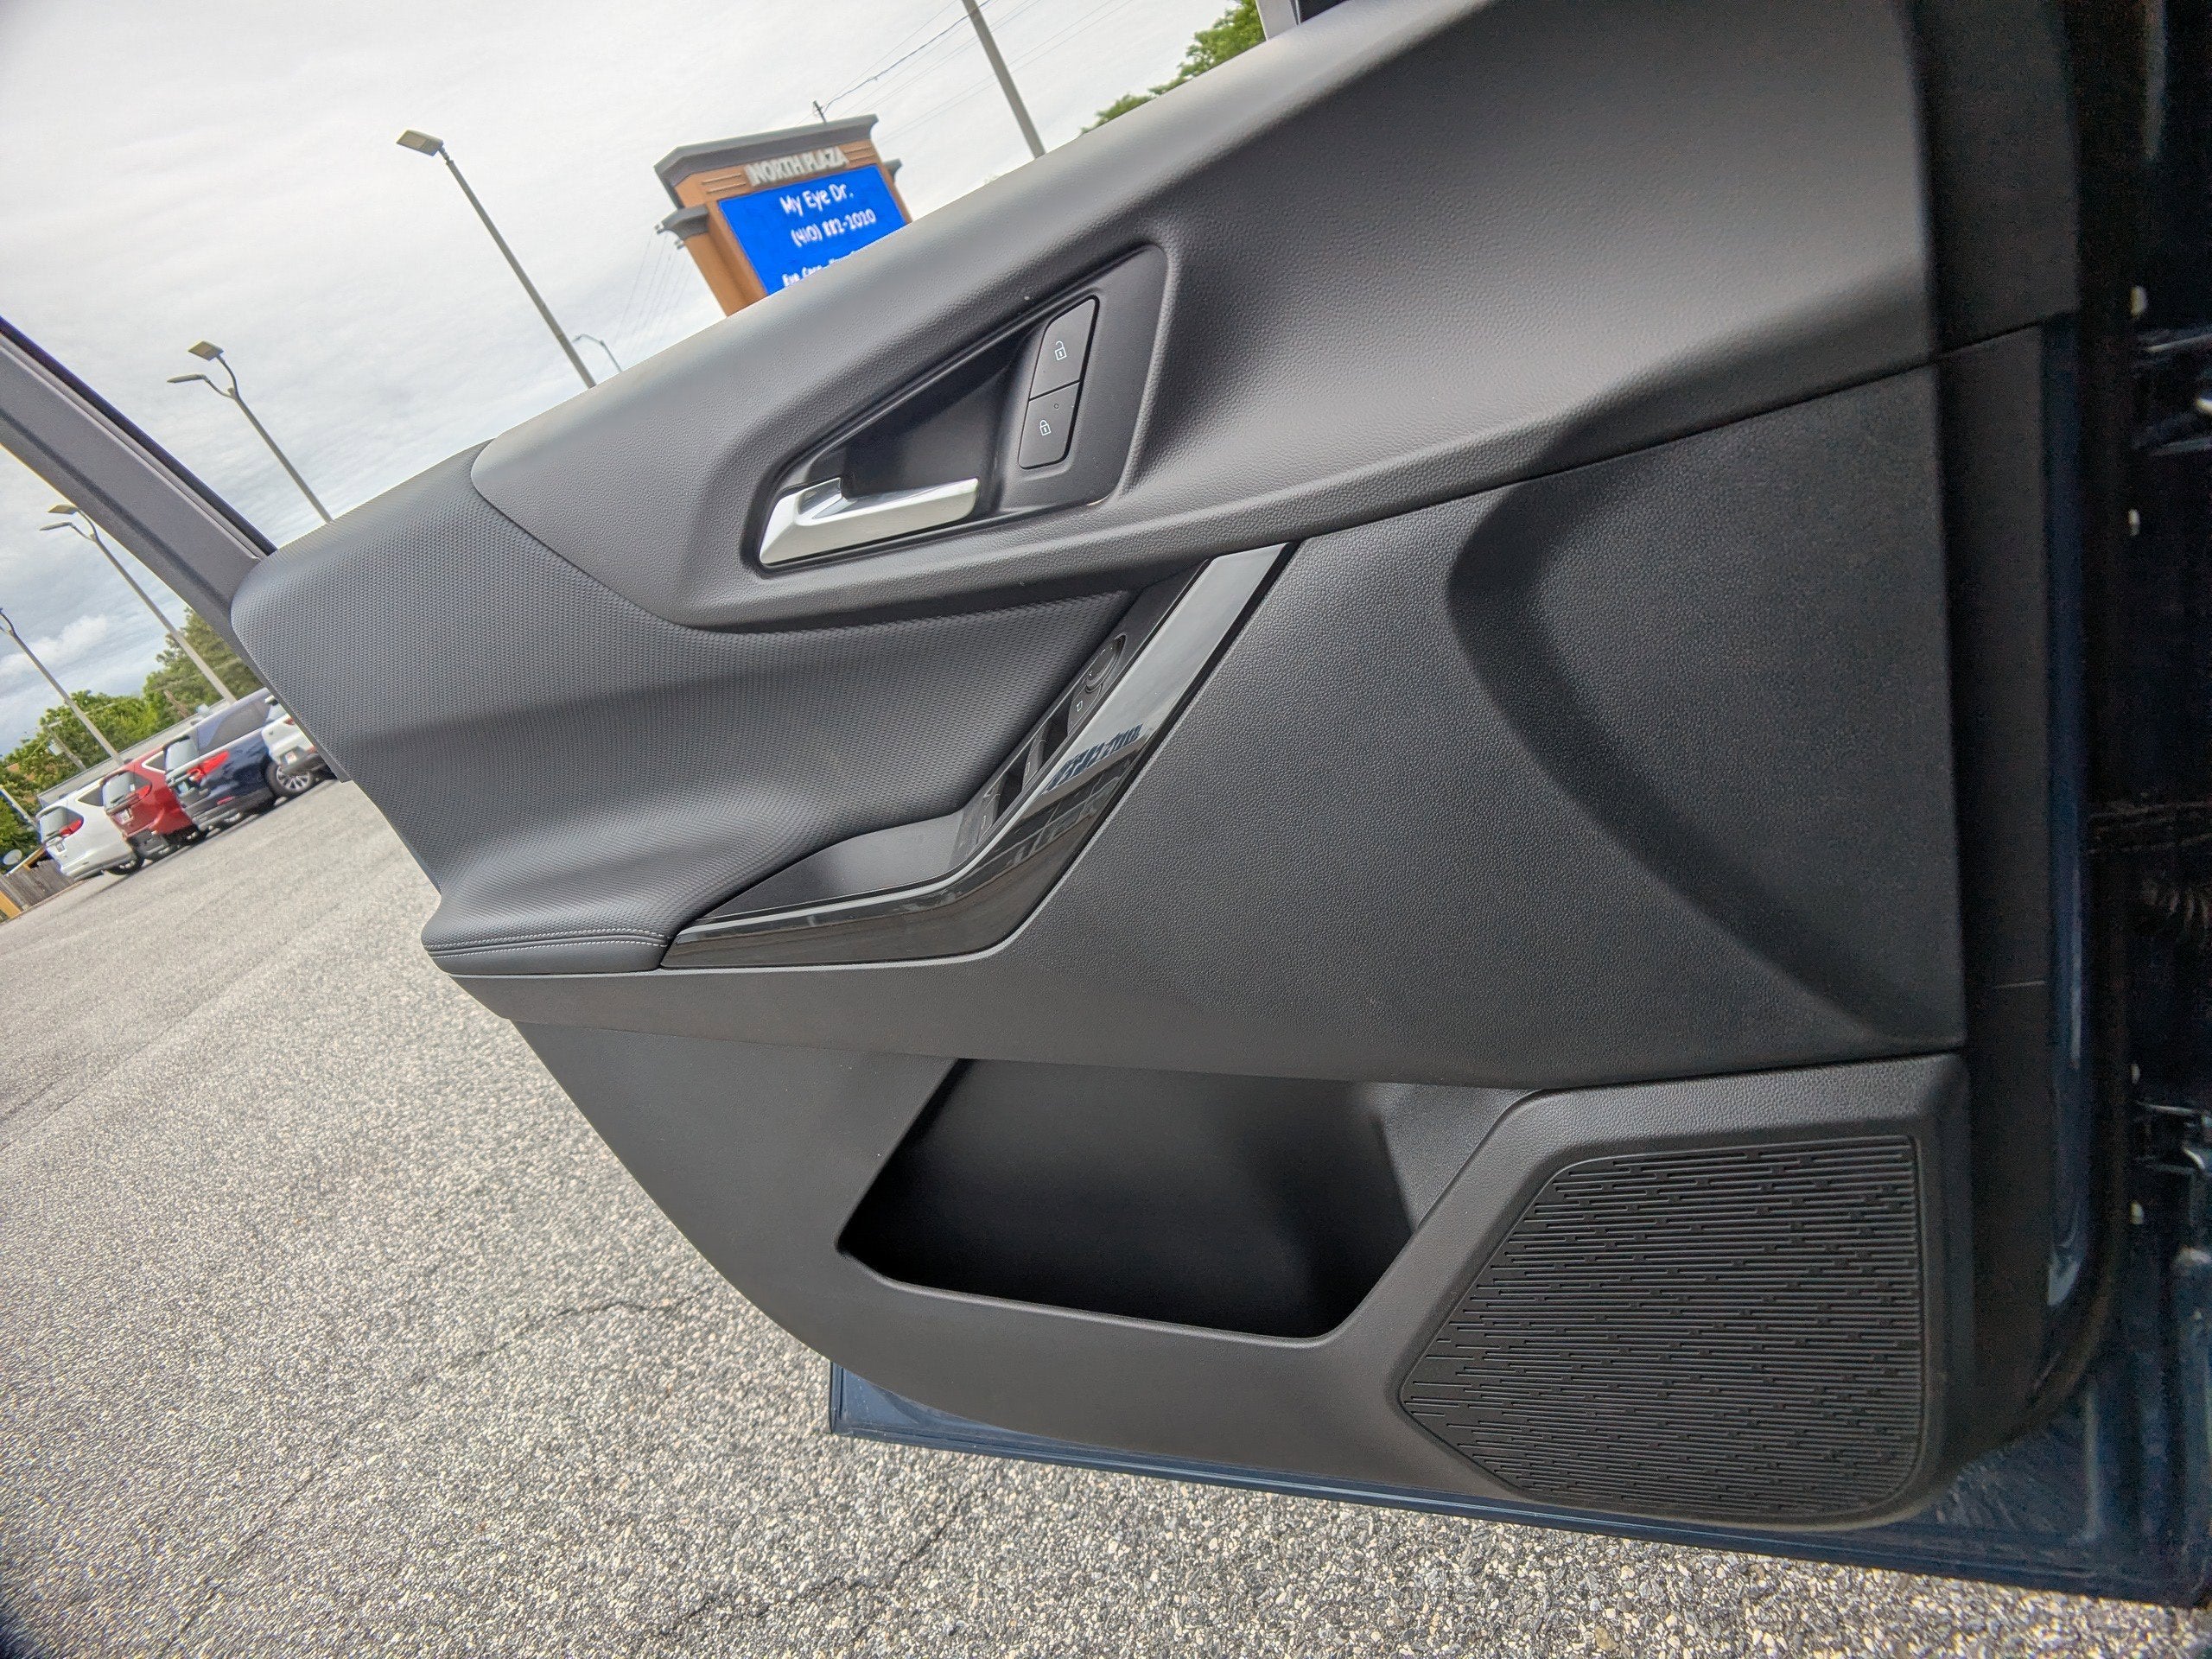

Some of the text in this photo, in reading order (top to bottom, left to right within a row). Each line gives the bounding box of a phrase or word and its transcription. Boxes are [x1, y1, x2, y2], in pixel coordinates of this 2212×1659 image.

[745, 145, 849, 186] NORTH PLAZA
[779, 183, 854, 217] My Eye Dr.
